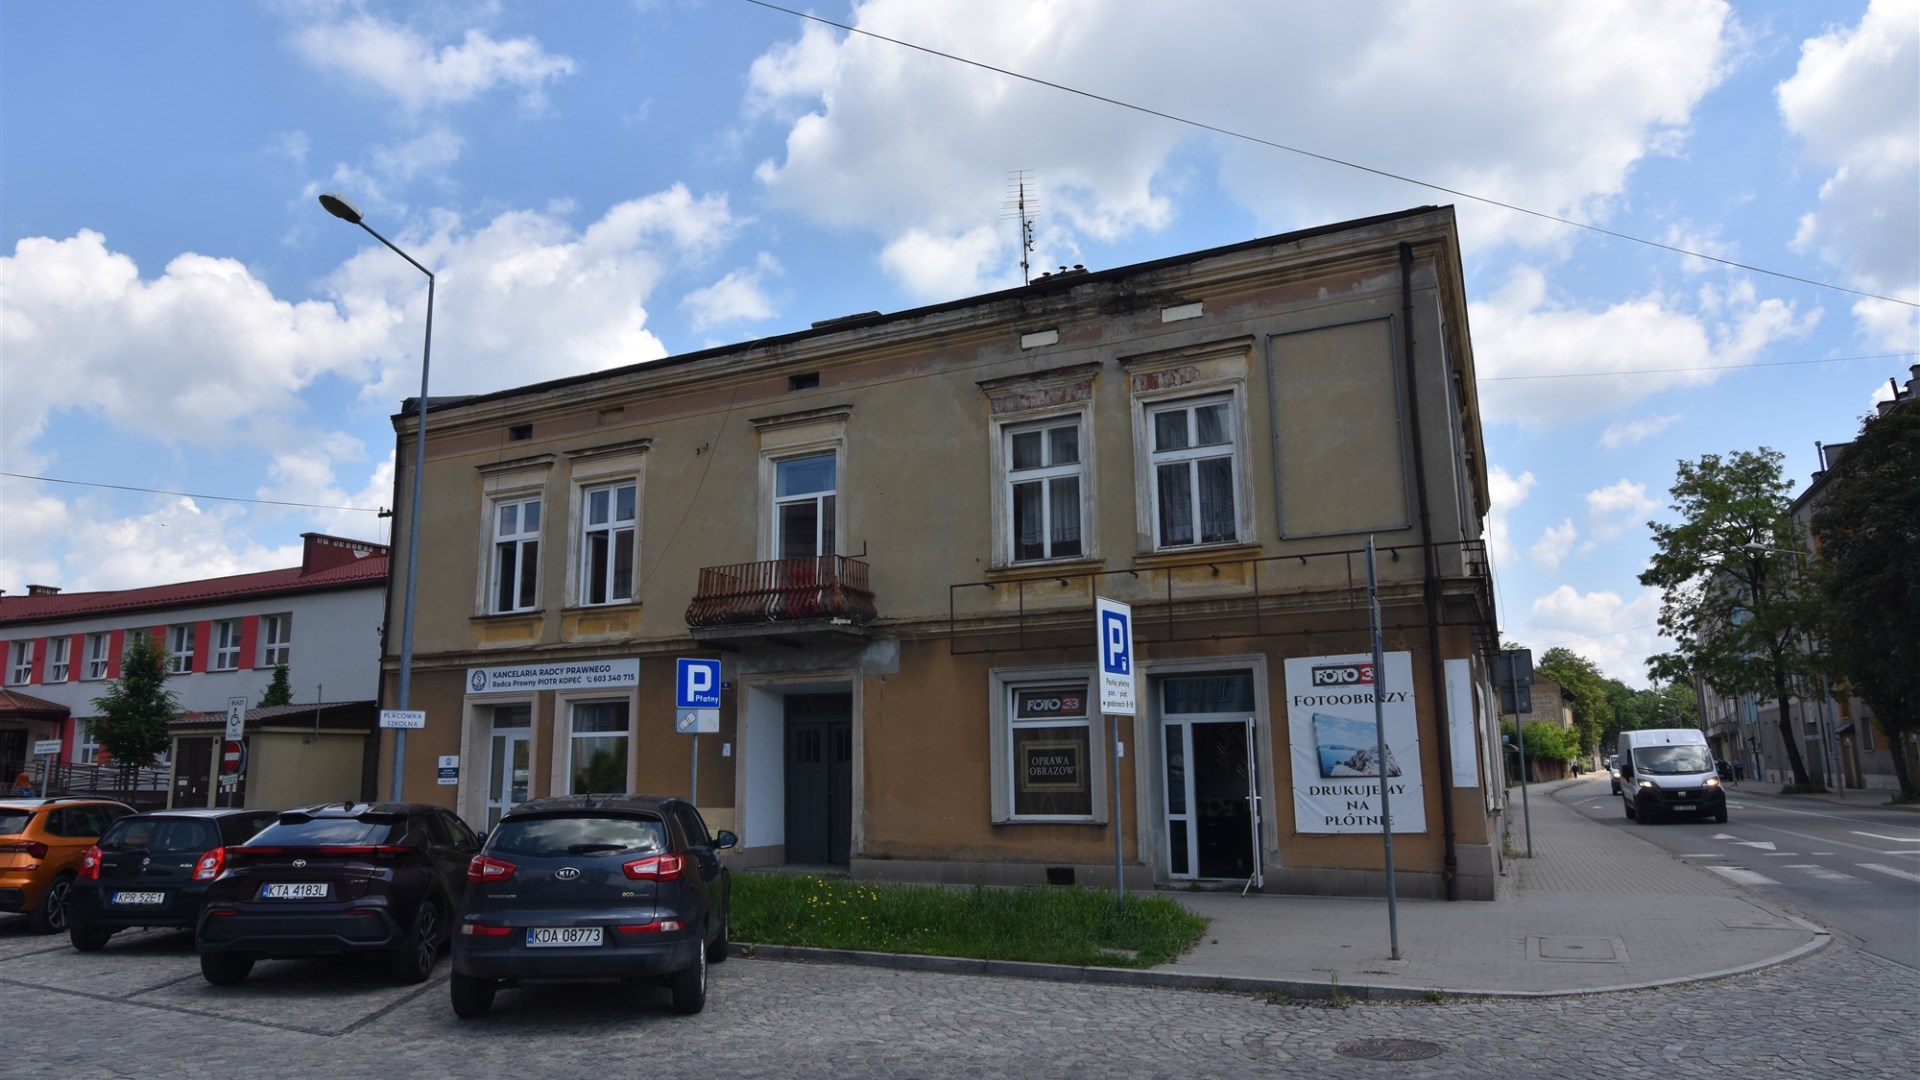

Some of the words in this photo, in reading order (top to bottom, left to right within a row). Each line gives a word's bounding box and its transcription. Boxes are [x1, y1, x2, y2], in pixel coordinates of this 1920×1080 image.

[1108, 617, 1124, 666] P
[492, 669, 538, 679] KANCELARIA
[538, 667, 565, 676] RADCY
[565, 665, 611, 675] PRAWNEGO
[1314, 667, 1359, 684] FOTO
[1360, 667, 1375, 681] 3
[512, 680, 536, 688] Prawny
[537, 678, 557, 686] PIOTR
[558, 676, 582, 685] KOPEĆ
[593, 675, 607, 683] 603
[608, 674, 622, 682] 340
[623, 673, 635, 681] 715
[687, 664, 712, 702] P
[695, 694, 719, 704] Płatny
[1026, 698, 1061, 711] FOTO
[1062, 697, 1079, 709] 33
[1294, 691, 1407, 707] FOTOOBRZY
[1031, 756, 1070, 766] OPRAWA
[1029, 765, 1075, 776] OBRAZÓW
[1309, 784, 1406, 798] DRUKUJEMY
[1346, 800, 1370, 810] NA
[268, 885, 290, 896] KTA
[292, 884, 325, 896] 4183L
[118, 894, 137, 903] KPR
[139, 893, 163, 903] 52E1
[535, 929, 559, 943] KDA
[562, 928, 601, 942] 08773
